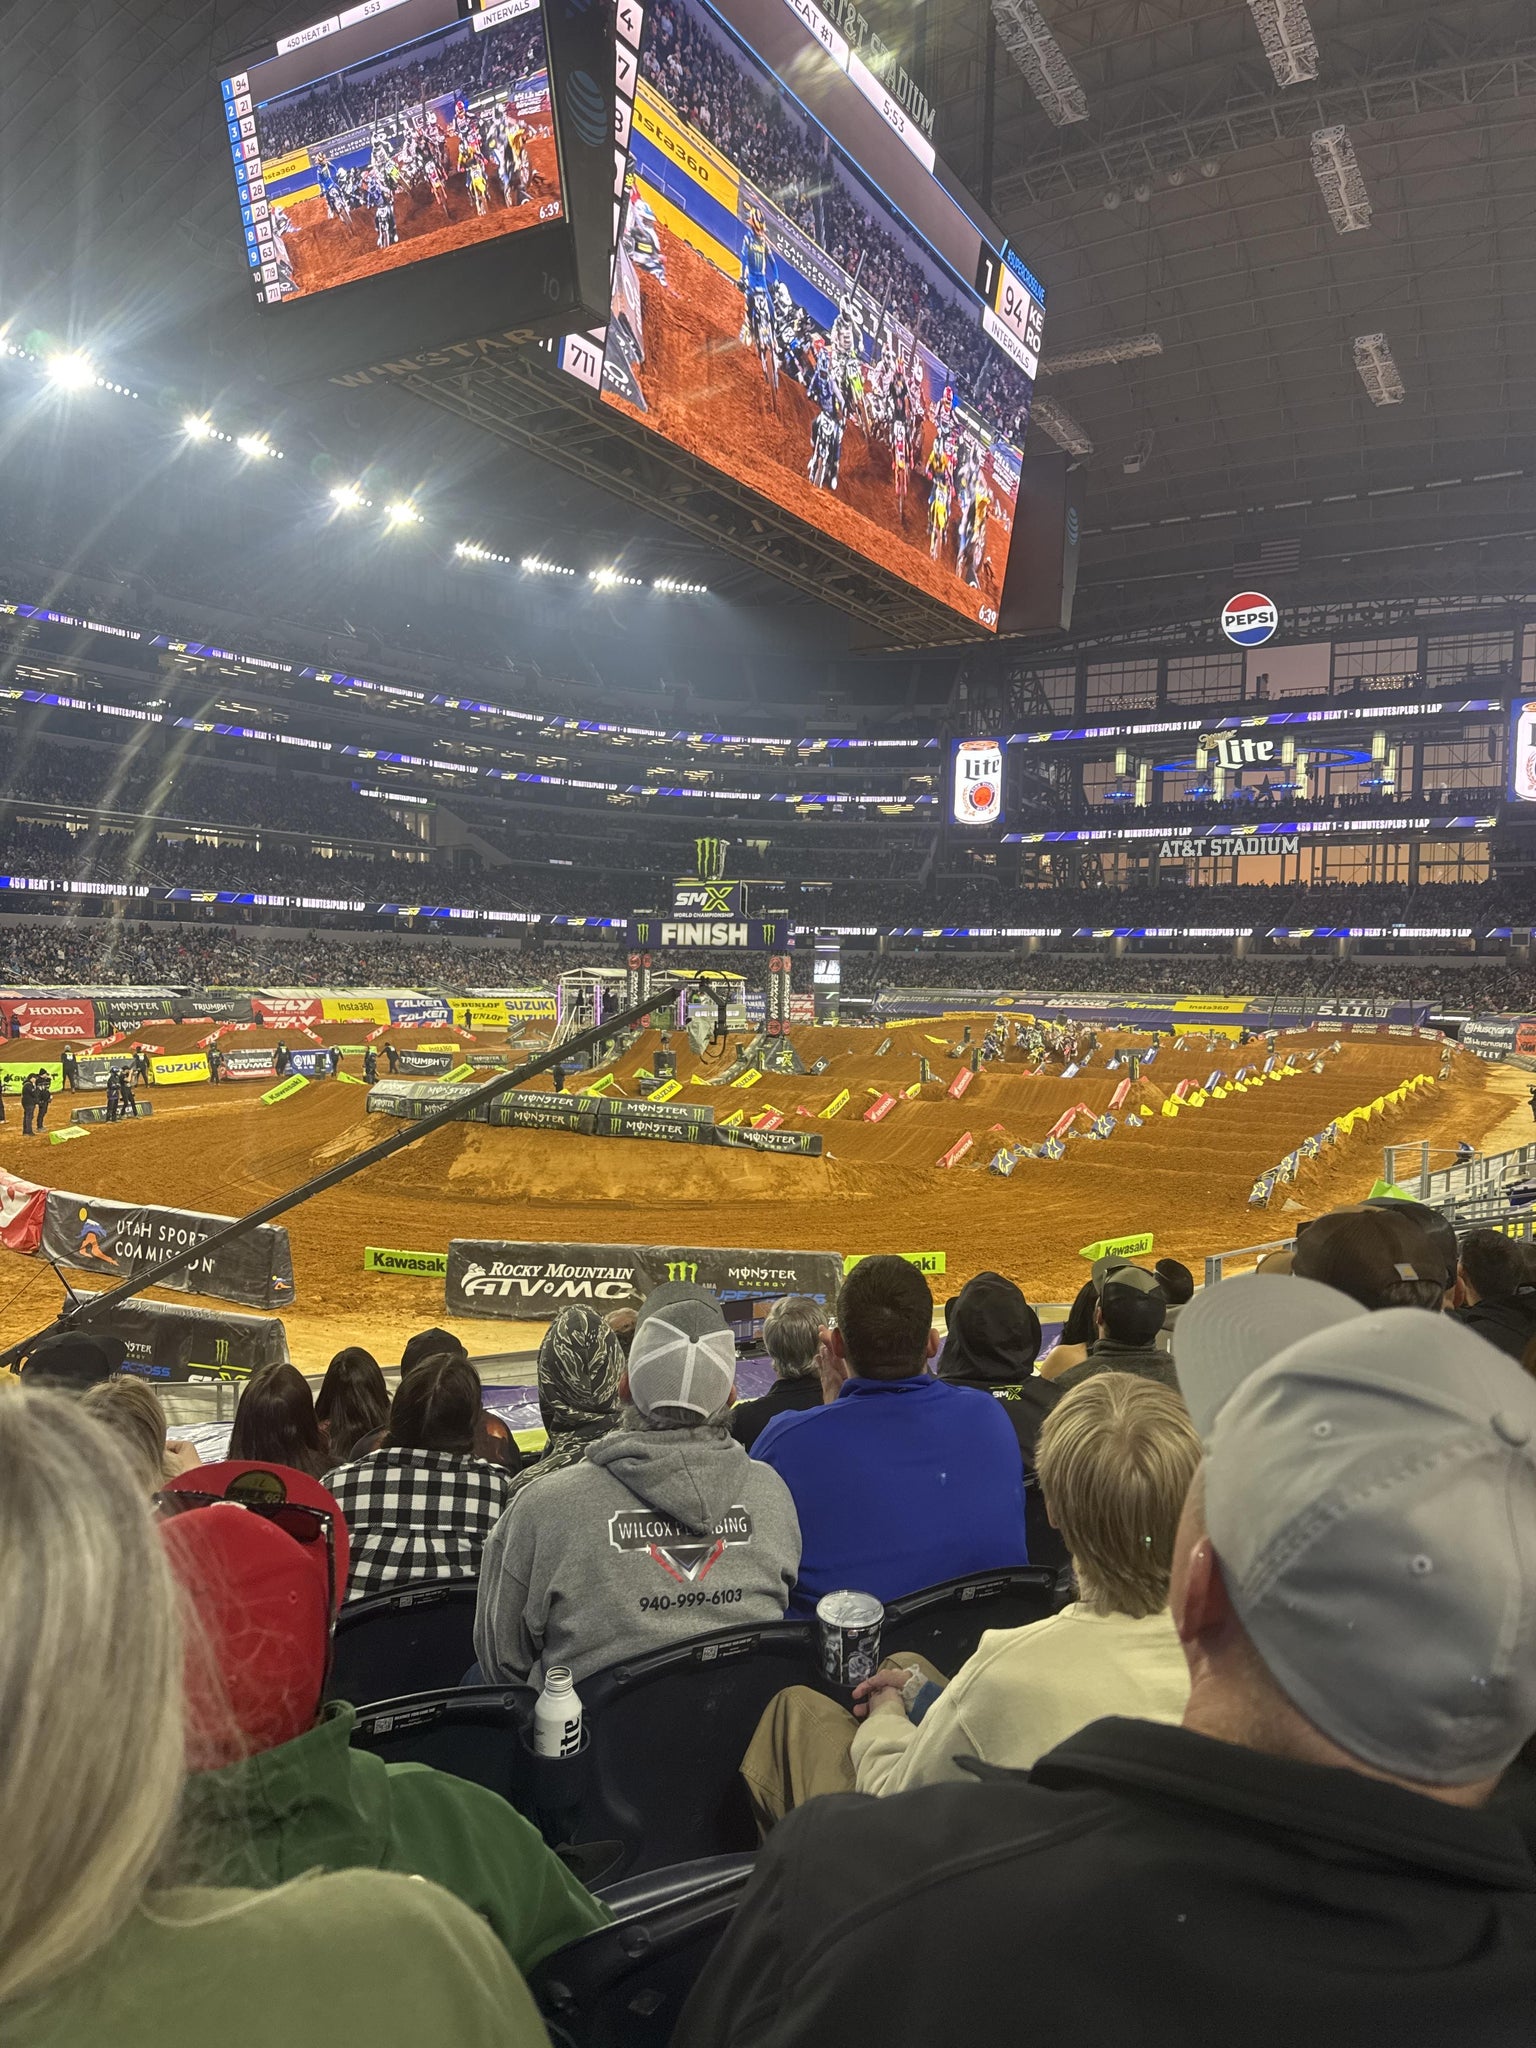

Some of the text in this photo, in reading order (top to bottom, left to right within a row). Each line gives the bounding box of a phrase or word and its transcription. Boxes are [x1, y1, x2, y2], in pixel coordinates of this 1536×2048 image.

[364, 2, 381, 16] 5:53
[483, 0, 530, 26] INTERVALS
[620, 9, 633, 31] 4
[287, 24, 330, 48] 450 HEAT #1
[821, 25, 833, 48] #1
[618, 55, 630, 80] 7
[236, 78, 246, 90] 94
[870, 33, 936, 139] STADIUM
[240, 100, 248, 111] 21
[883, 100, 905, 133] 5:53
[243, 122, 253, 132] 32
[246, 143, 255, 153] 14
[250, 164, 259, 175] 27
[252, 185, 262, 196] 28
[256, 206, 265, 217] 20
[539, 201, 559, 220] 6:39
[259, 227, 268, 237] 12
[262, 247, 272, 257] 63
[776, 233, 803, 261] UTAH
[253, 272, 261, 282] 10
[256, 292, 264, 302] 11
[268, 288, 278, 299] 711
[985, 259, 1044, 332] 1 94 KE
[992, 320, 1029, 369] INTERVALS
[1026, 326, 1041, 353] RO
[571, 344, 595, 378] 711
[978, 604, 997, 626] 6:39
[1225, 611, 1274, 626] PEPSI
[1427, 704, 1442, 713] LAP
[1216, 739, 1274, 769] Lite
[964, 757, 1000, 781] Lite
[1415, 819, 1430, 828] LAP
[1159, 837, 1299, 858] AT&T STADIUM
[135, 886, 149, 897] LAP
[674, 887, 734, 911] SMX
[662, 923, 748, 946] FINISH
[110, 1001, 159, 1010] MONSTER
[192, 1003, 227, 1011] TRIUMPH
[338, 1003, 374, 1011] Insta360
[394, 1000, 443, 1008] FALKEN
[505, 1000, 555, 1011] SUZUKI
[29, 1007, 84, 1015] HONDA
[398, 1010, 449, 1022] FALKEN
[1317, 1005, 1362, 1017] 5.11
[33, 1025, 85, 1034] HONDA
[114, 1020, 141, 1030] MONS
[1474, 1024, 1514, 1035] Husqvarna
[205, 1031, 219, 1044] FLY
[303, 1027, 317, 1038] FLY
[371, 1027, 384, 1039] FLY
[460, 1028, 472, 1039] FLY
[101, 1036, 116, 1048] FLY
[156, 1060, 206, 1074] SUZUKI
[401, 1057, 439, 1066] TRIUMPH
[269, 1078, 302, 1100] Kawasaki
[427, 1085, 472, 1095] MONSTER
[652, 1082, 678, 1102] SUZUKI
[517, 1094, 574, 1106] MONSTER
[829, 1094, 849, 1117] SUZUKI
[627, 1103, 688, 1116] MONSTER
[513, 1111, 565, 1125] MONSTER
[626, 1121, 683, 1135] MONSTER
[743, 1131, 796, 1144] MONSTER
[117, 1220, 152, 1239] UTAH
[1105, 1238, 1148, 1257] Kawasaki
[373, 1252, 447, 1272] Kawasak
[491, 1261, 635, 1280] ROCKY MOUNTAIN
[728, 1266, 797, 1280] MONSTER
[992, 1387, 1022, 1400] SMX
[619, 1521, 673, 1539] WILCOX
[639, 1589, 742, 1612] 940-999-6103
